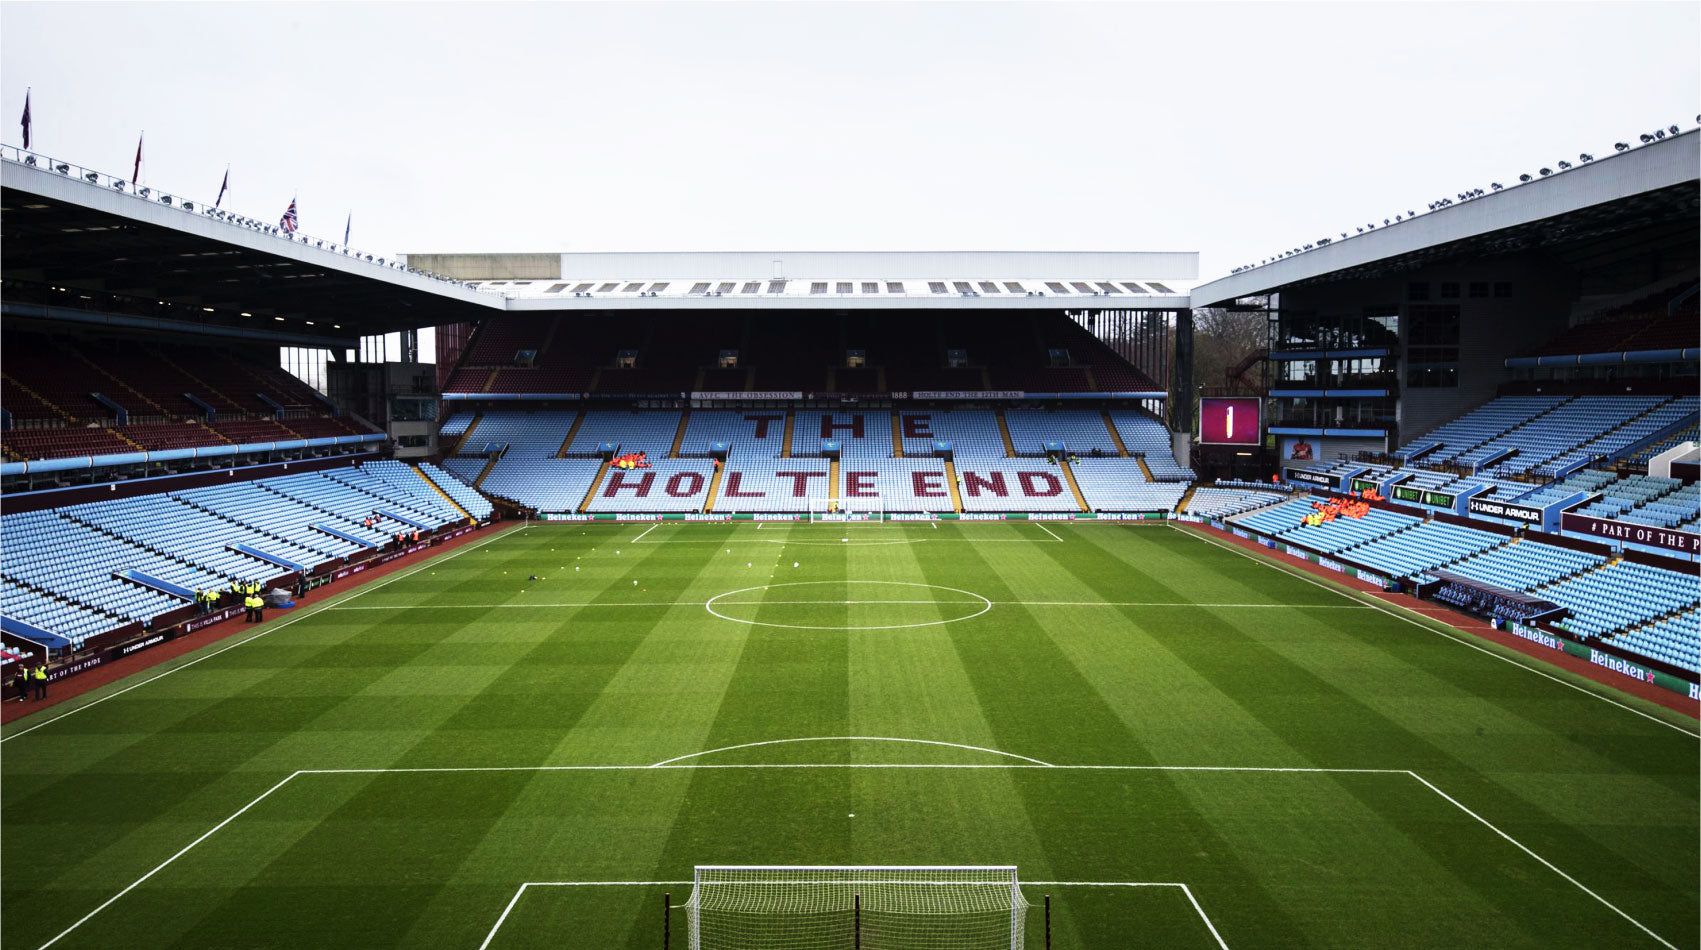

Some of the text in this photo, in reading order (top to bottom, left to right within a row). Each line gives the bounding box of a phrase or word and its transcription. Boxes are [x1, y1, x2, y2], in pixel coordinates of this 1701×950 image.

[604, 471, 1064, 498] HOLTE END
[1479, 503, 1539, 521] UNDER ARMOUR
[547, 513, 588, 521] Heineken
[616, 513, 657, 521] Heineken
[685, 513, 726, 521] Heineken
[753, 513, 794, 521] Heineken
[890, 513, 931, 521] Heineken
[959, 513, 1001, 521] Heineken
[1028, 513, 1069, 521] Heineken
[1097, 513, 1138, 521] Heineken
[1602, 523, 1631, 539] PART
[1637, 529, 1653, 541] OF
[1659, 533, 1685, 548] THE
[1512, 622, 1556, 649] Heineken
[70, 664, 82, 673] THE
[1590, 649, 1645, 681] Heineken
